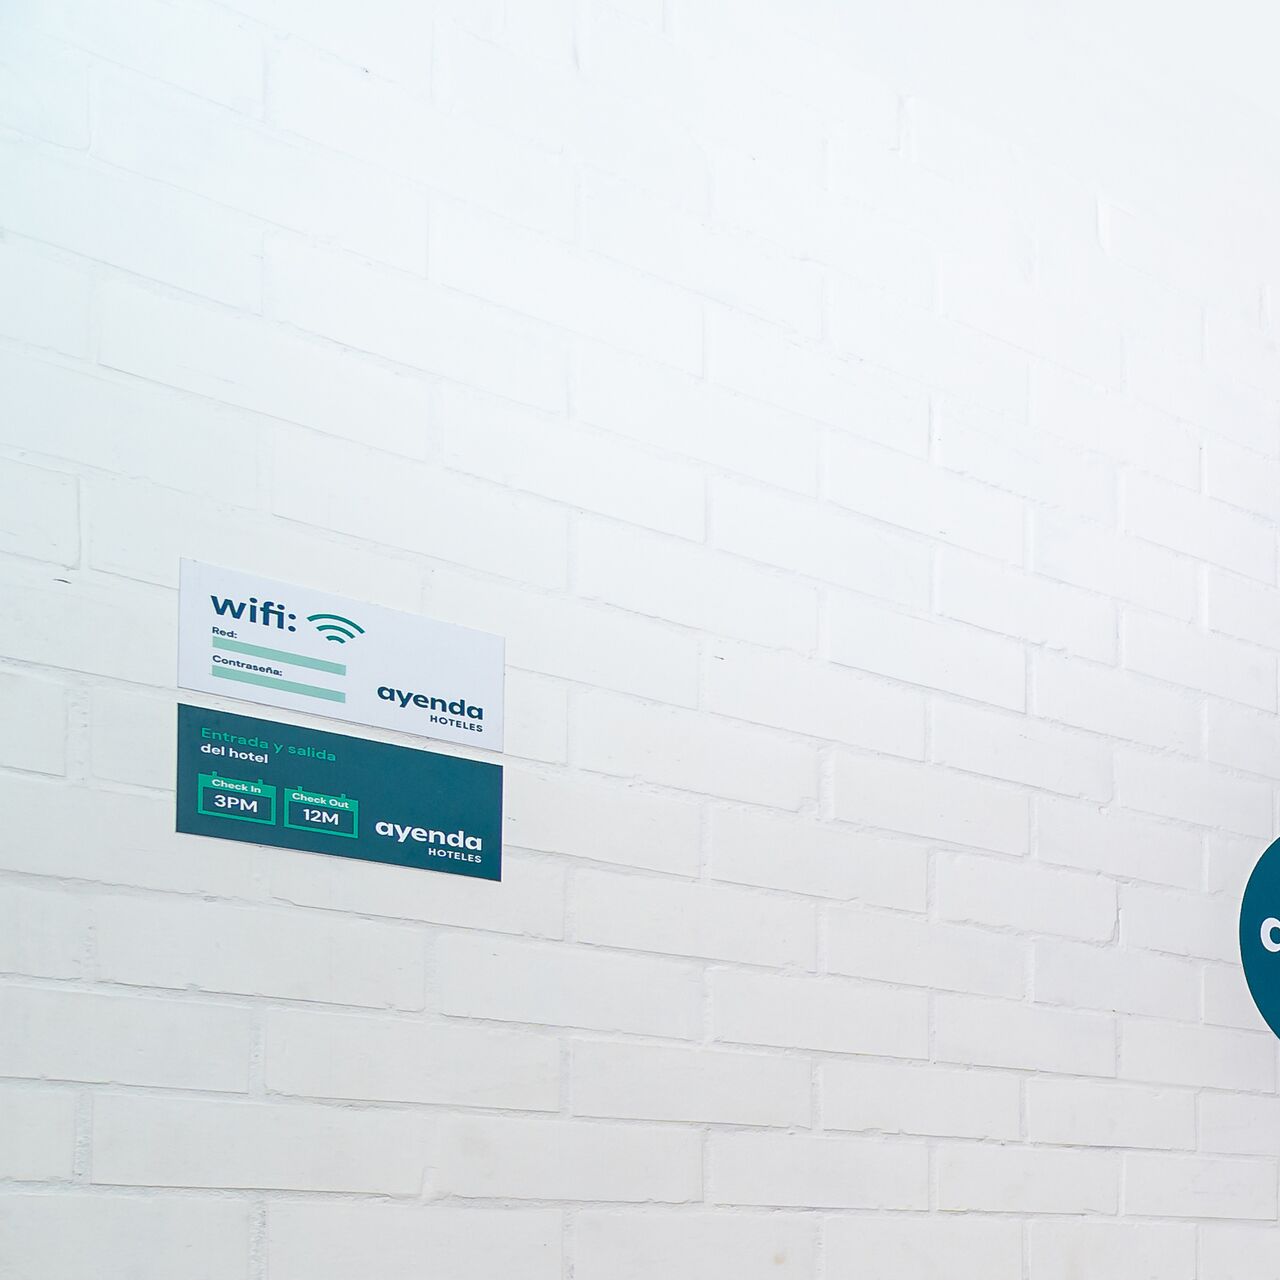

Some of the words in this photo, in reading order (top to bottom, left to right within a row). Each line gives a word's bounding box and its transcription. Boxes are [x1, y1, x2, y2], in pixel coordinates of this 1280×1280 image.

[210, 595, 297, 632] wifi:
[212, 626, 238, 639] Red:
[212, 655, 283, 676] Contraseña:
[376, 686, 484, 720] ayenda
[429, 714, 484, 733] HOTELES
[200, 743, 225, 756] del
[229, 747, 269, 764] hotel
[201, 727, 269, 749] Entrada
[273, 743, 283, 754] y
[288, 745, 336, 762] salida
[211, 779, 248, 792] Check
[250, 784, 262, 794] In
[214, 794, 258, 813] 3PM
[291, 792, 327, 805] Check
[328, 798, 350, 809] Out
[303, 808, 340, 826] 12M
[375, 820, 482, 851] ayenda
[428, 848, 482, 864] HOTELES
